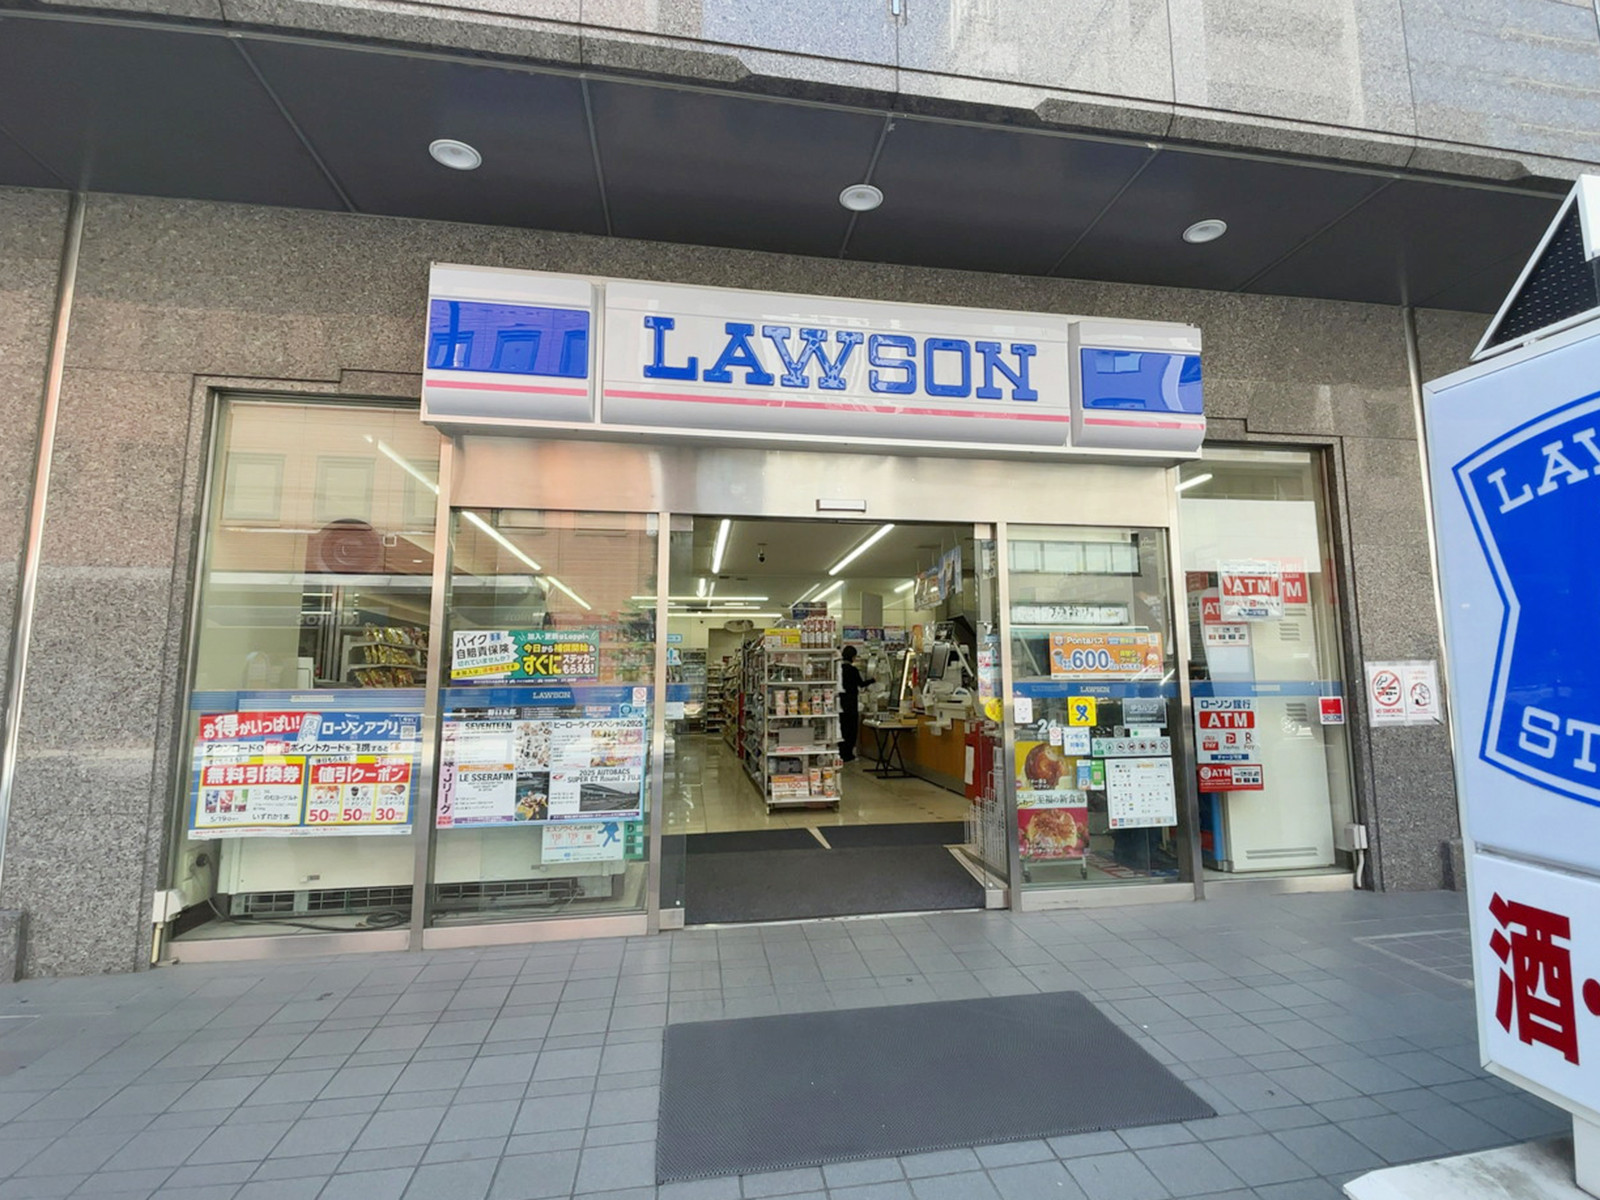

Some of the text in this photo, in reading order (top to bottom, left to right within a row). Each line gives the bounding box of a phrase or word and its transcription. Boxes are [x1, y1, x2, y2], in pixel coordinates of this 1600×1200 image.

[643, 316, 1038, 401] LAWSON
[1233, 579, 1271, 593] ATM
[456, 634, 487, 648] バイク
[523, 654, 562, 675] すぐに
[562, 654, 596, 664] ステッカー
[1072, 650, 1109, 669] 600
[562, 664, 594, 674] もらえる!
[533, 691, 570, 699] LAWSON
[1201, 700, 1251, 709] ローソン銀行
[203, 715, 300, 738] お得がいっぱい!
[465, 722, 512, 730] SEVENTEEN
[1208, 713, 1247, 727] ATM
[322, 720, 398, 735] ローソンアプリ
[207, 766, 300, 784] 無料引換券
[318, 767, 404, 783] 値引クーポン
[460, 772, 514, 782] LE SSERAFIM
[1212, 768, 1231, 777] ATM
[309, 809, 329, 821] 50
[343, 808, 362, 821] 50
[376, 808, 395, 821] 30
